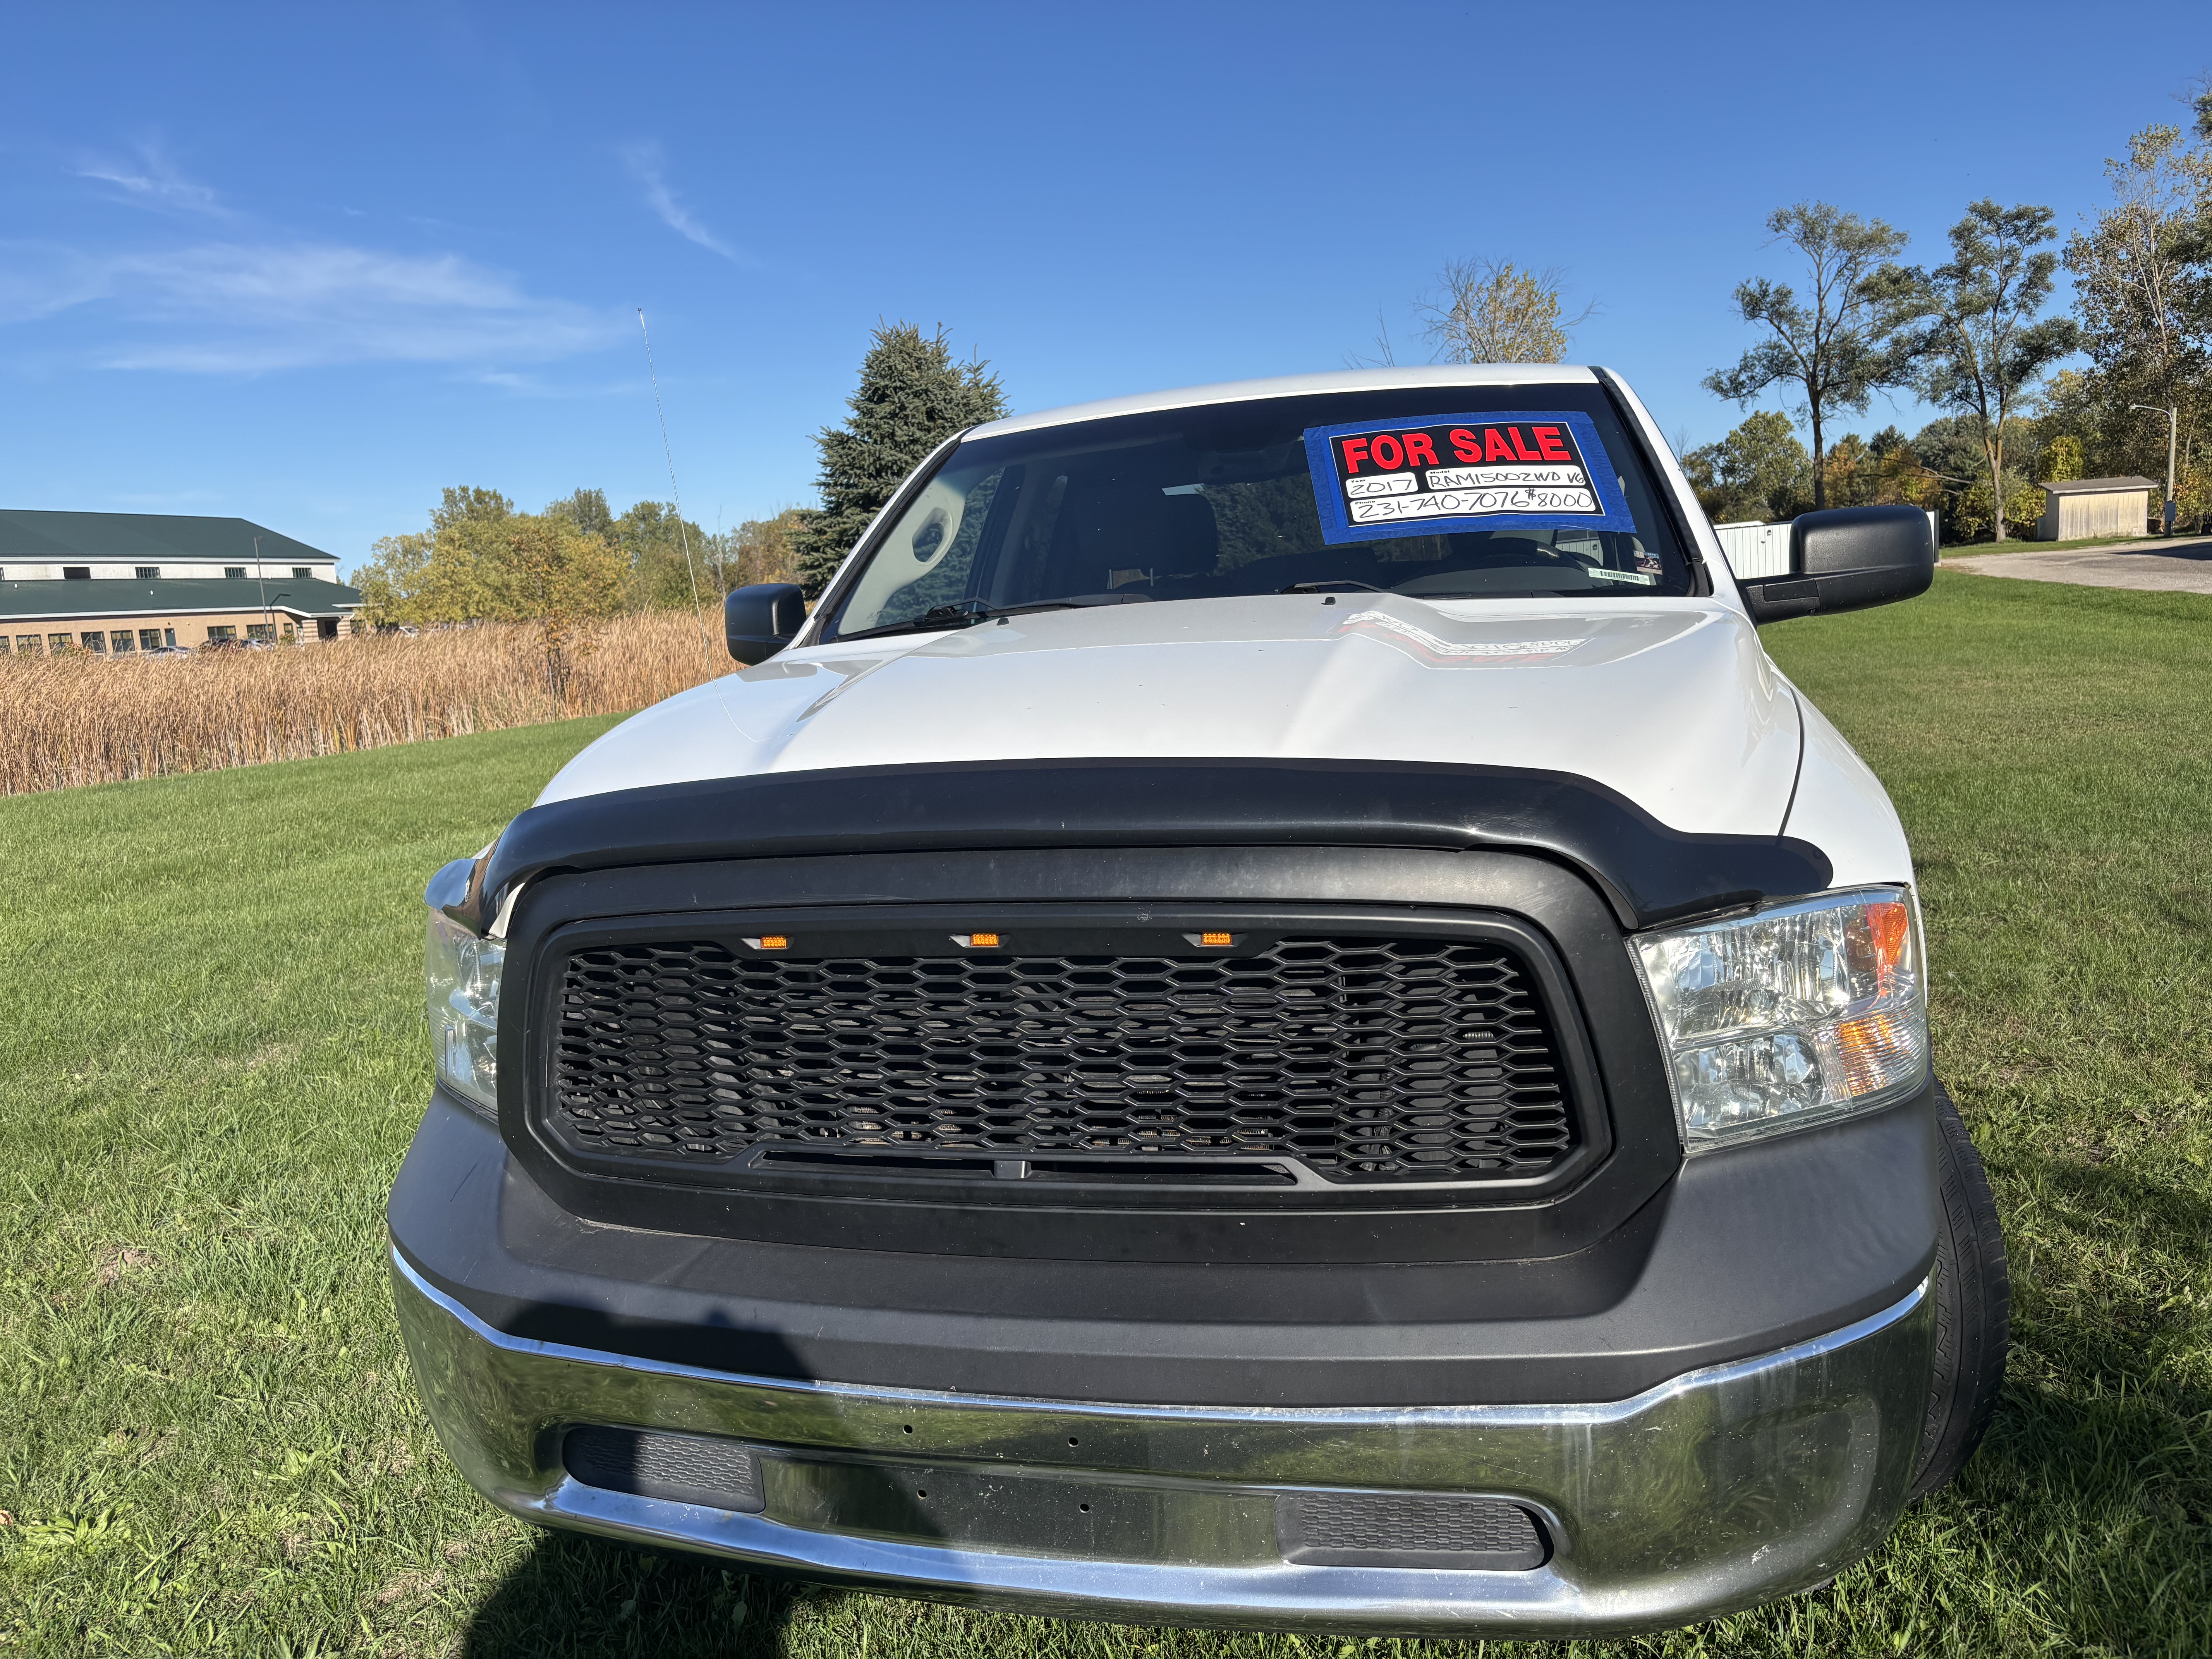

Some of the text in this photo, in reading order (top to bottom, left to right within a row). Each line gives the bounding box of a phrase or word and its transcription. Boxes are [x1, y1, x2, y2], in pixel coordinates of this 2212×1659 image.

[1342, 427, 1572, 474] FOR SALE
[1566, 472, 1584, 483] V6
[1350, 479, 1412, 495] 2017
